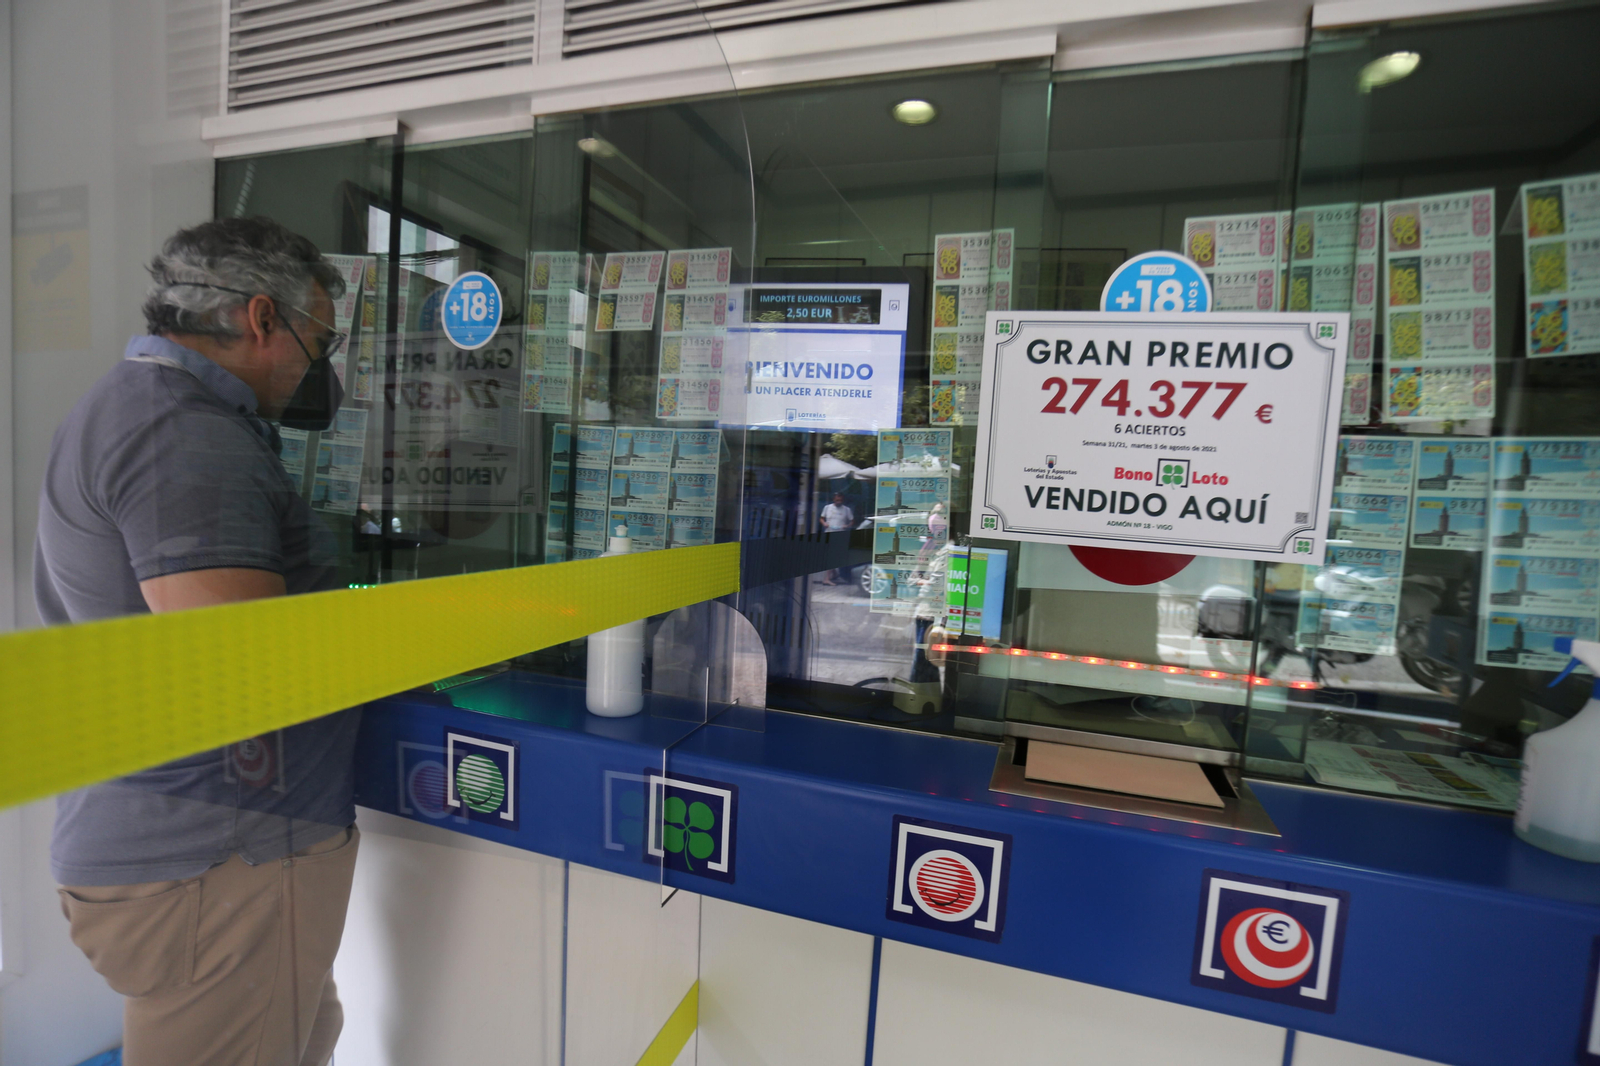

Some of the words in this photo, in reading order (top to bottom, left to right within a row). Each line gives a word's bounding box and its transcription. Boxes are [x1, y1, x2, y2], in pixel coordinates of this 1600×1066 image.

[1218, 220, 1259, 232] 12714
[690, 253, 718, 262] 31456
[1217, 274, 1257, 284] 12714
[686, 295, 714, 303] 31456
[760, 295, 796, 303] IMPORTE
[797, 295, 862, 303] EUROMILLONES
[1115, 279, 1185, 312] +18
[1186, 280, 1199, 312] NOS
[449, 291, 488, 321] +18
[488, 292, 496, 320] AÑOS
[786, 308, 809, 318] 2,50
[811, 308, 832, 318] EUR
[682, 338, 712, 346] 31456
[1026, 339, 1131, 366] GRAN
[1146, 341, 1294, 370] PREMIO
[680, 381, 709, 389] 31456
[756, 387, 771, 395] UN
[774, 387, 811, 396] PLACER
[814, 388, 872, 398] ATENDERLE
[1040, 376, 1248, 421] 274.377
[1254, 404, 1274, 424] €
[1114, 424, 1121, 434] 6
[1125, 424, 1186, 437] ACIERTOS
[680, 432, 707, 440] 87626
[904, 433, 936, 441] 50625
[1169, 444, 1190, 452] agosto
[1349, 442, 1394, 452] 90664
[577, 470, 597, 478] 5597
[677, 475, 704, 483] 87626
[1114, 467, 1153, 481] Bono
[1192, 471, 1229, 485] Loto
[1024, 485, 1167, 517] VENDIDO
[1179, 493, 1270, 524] AQUÍ
[1343, 495, 1388, 506] 90664
[575, 510, 595, 518] 5597
[628, 514, 654, 522] 95496
[674, 517, 701, 525] 87626
[1337, 550, 1382, 560] 90664
[947, 570, 971, 580] IMO
